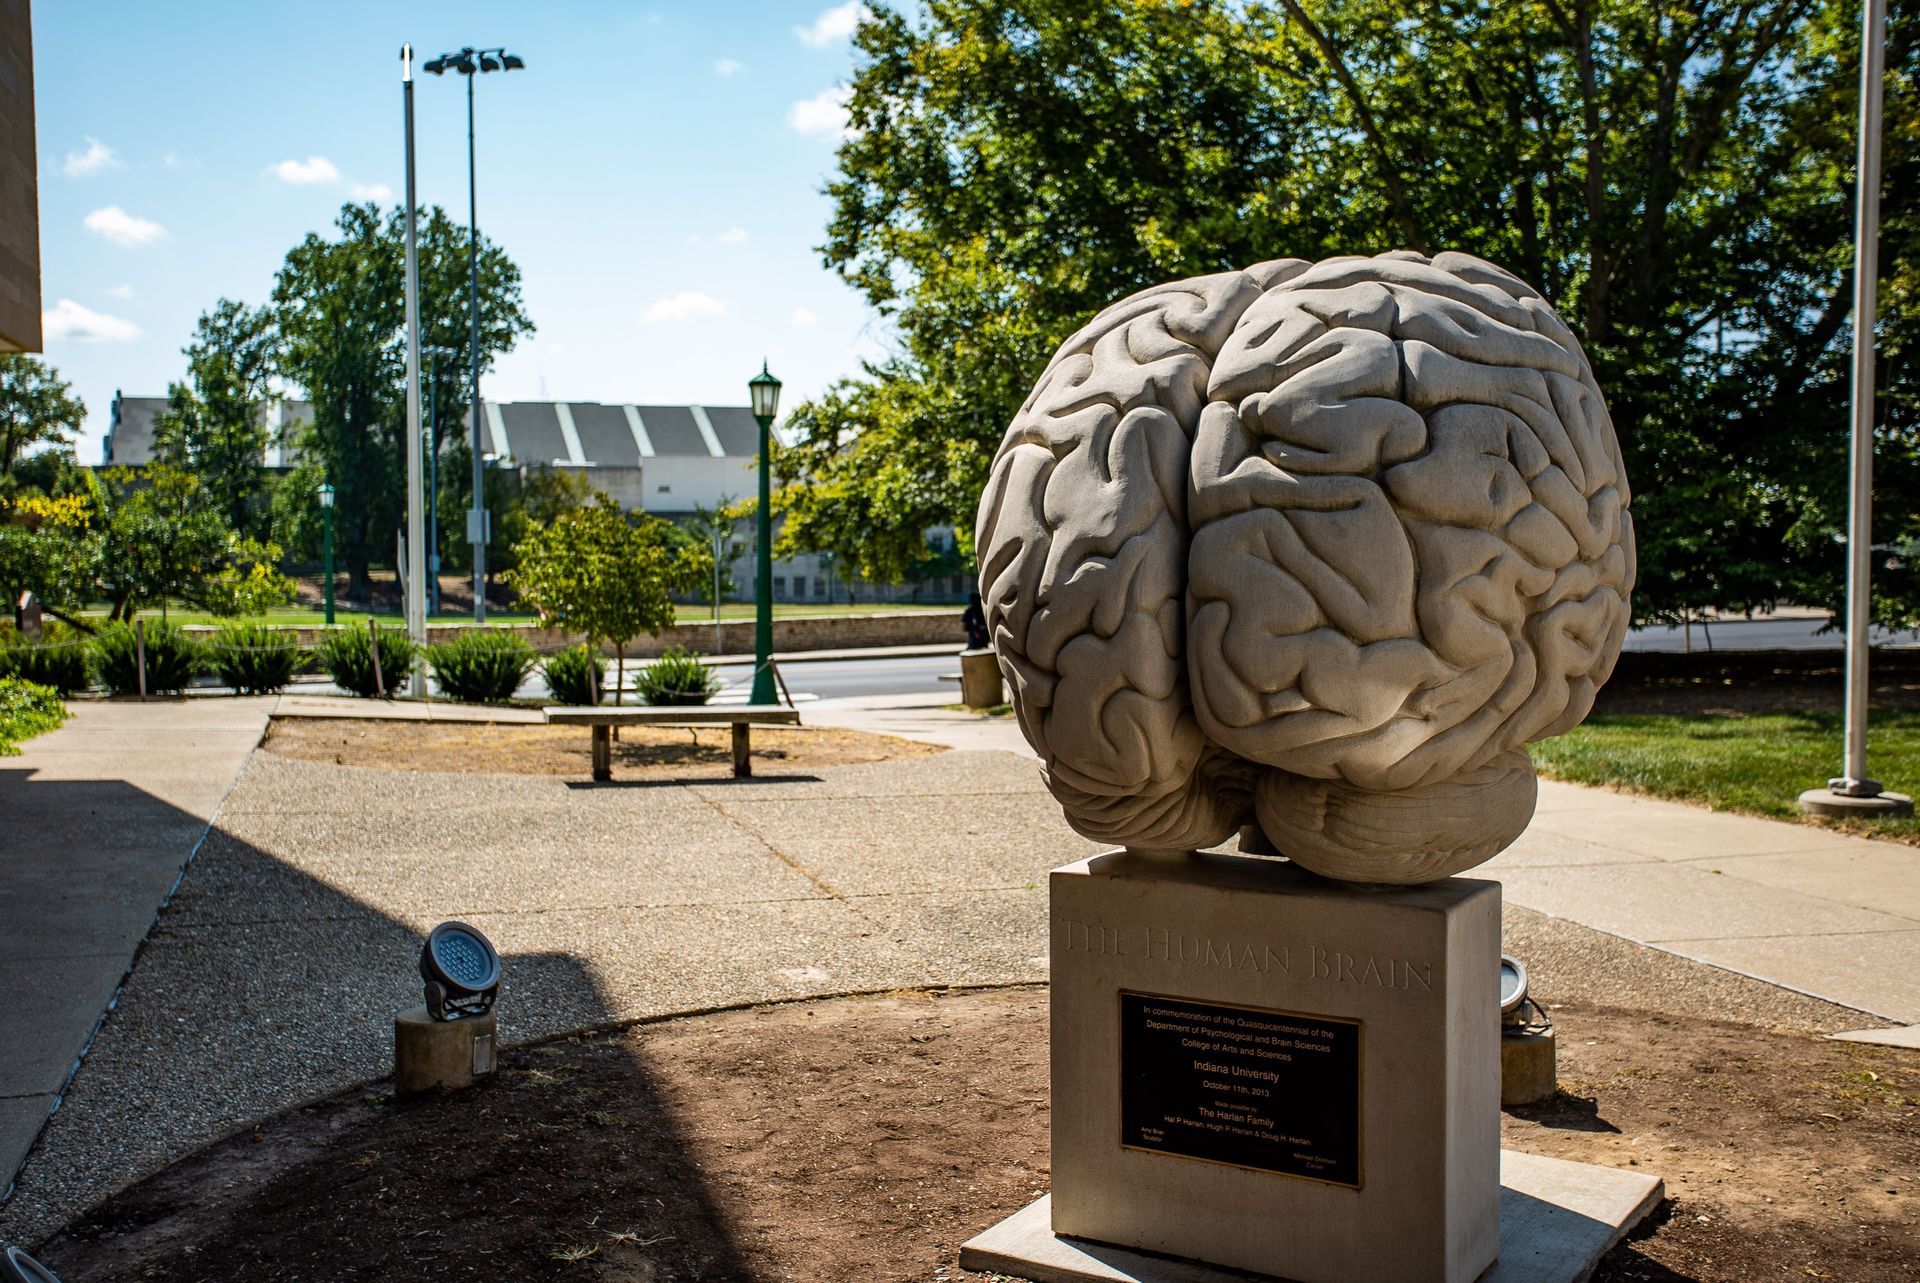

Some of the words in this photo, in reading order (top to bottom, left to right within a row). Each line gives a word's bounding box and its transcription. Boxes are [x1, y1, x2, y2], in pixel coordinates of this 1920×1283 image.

[1058, 917, 1128, 956] THE
[1144, 926, 1290, 974] HUMAN
[1309, 944, 1432, 992] BRAIN
[1143, 1005, 1151, 1014] In
[1152, 1008, 1212, 1022] commemoration
[1213, 1015, 1221, 1024] of
[1222, 1016, 1235, 1026] the
[1237, 1018, 1309, 1036] Quasquicentennial
[1311, 1029, 1319, 1037] of
[1321, 1030, 1335, 1039] the
[1146, 1019, 1190, 1033] Department
[1191, 1026, 1200, 1034] of
[1201, 1027, 1253, 1042] Psychological
[1254, 1034, 1270, 1044] and
[1271, 1036, 1292, 1048] Brain
[1294, 1040, 1331, 1053] Sciences
[1182, 1038, 1211, 1051] College
[1212, 1043, 1221, 1052] of
[1222, 1043, 1238, 1054] Arts
[1240, 1047, 1255, 1056] and
[1256, 1048, 1292, 1062] Sciences
[1194, 1060, 1229, 1075] Indiana
[1231, 1065, 1280, 1084] University
[1202, 1080, 1231, 1092] October
[1251, 1087, 1270, 1098] 2013
[1198, 1106, 1215, 1118] The
[1217, 1110, 1245, 1122] Harlan
[1247, 1115, 1275, 1129] Family
